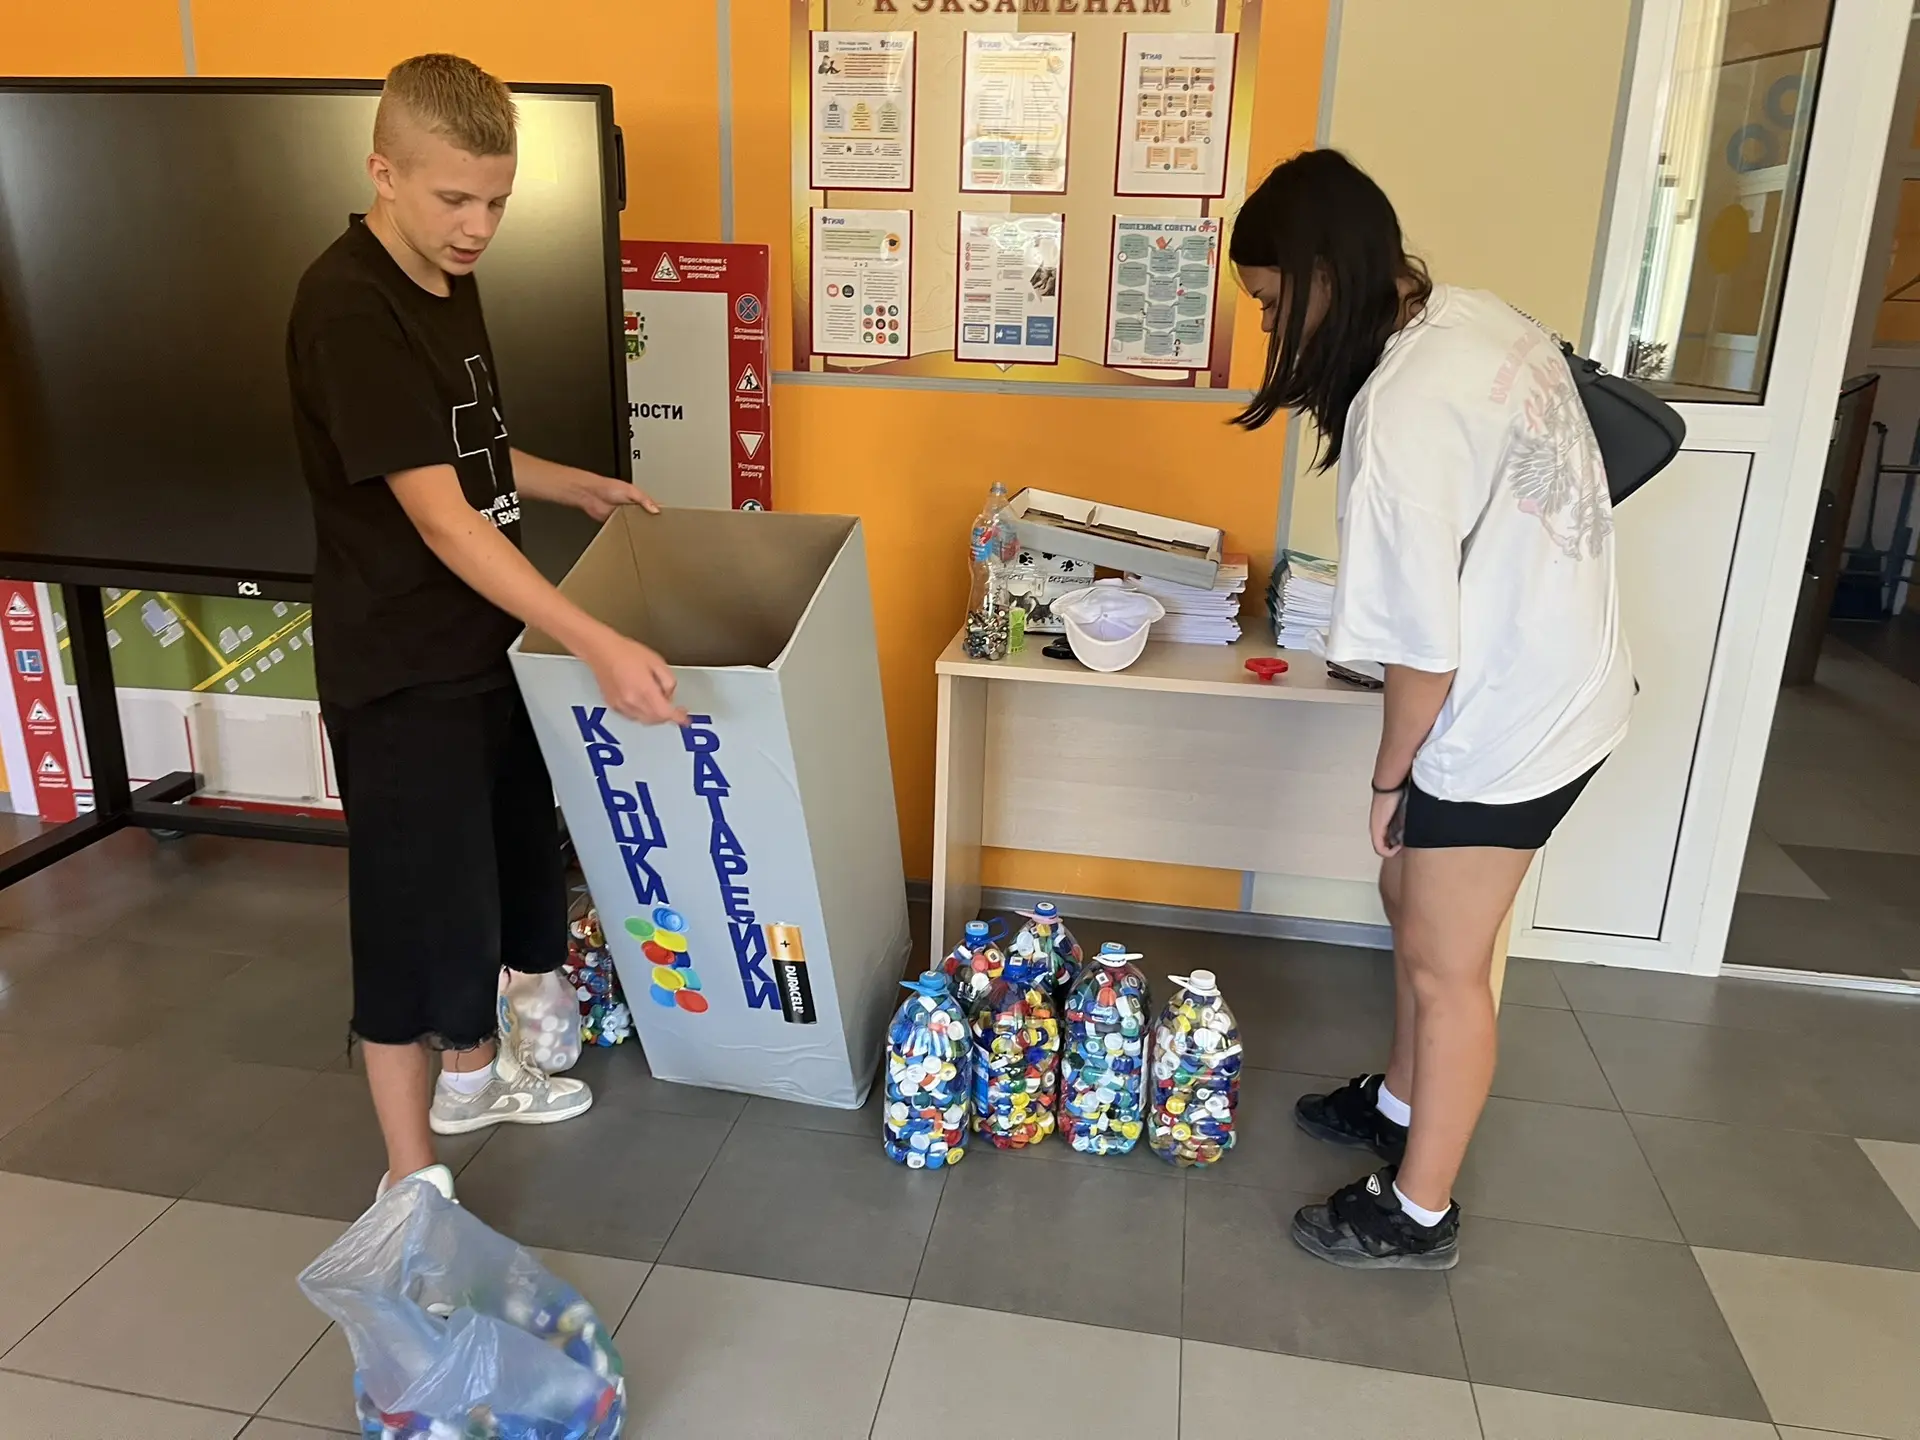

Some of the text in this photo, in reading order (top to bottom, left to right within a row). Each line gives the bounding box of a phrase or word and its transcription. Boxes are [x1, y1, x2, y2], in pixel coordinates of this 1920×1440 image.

[874, 0, 1171, 13] К ЭКЗАМЕНАМ
[1119, 223, 1162, 231] ПОЛЕЗНЫЕ
[679, 256, 722, 265] Пересечение
[680, 264, 727, 272] велосипедной
[571, 706, 670, 905] КРЫШКИ
[680, 714, 782, 1010] БАТАРЕЙКИ
[784, 965, 804, 1014] DURACELL
